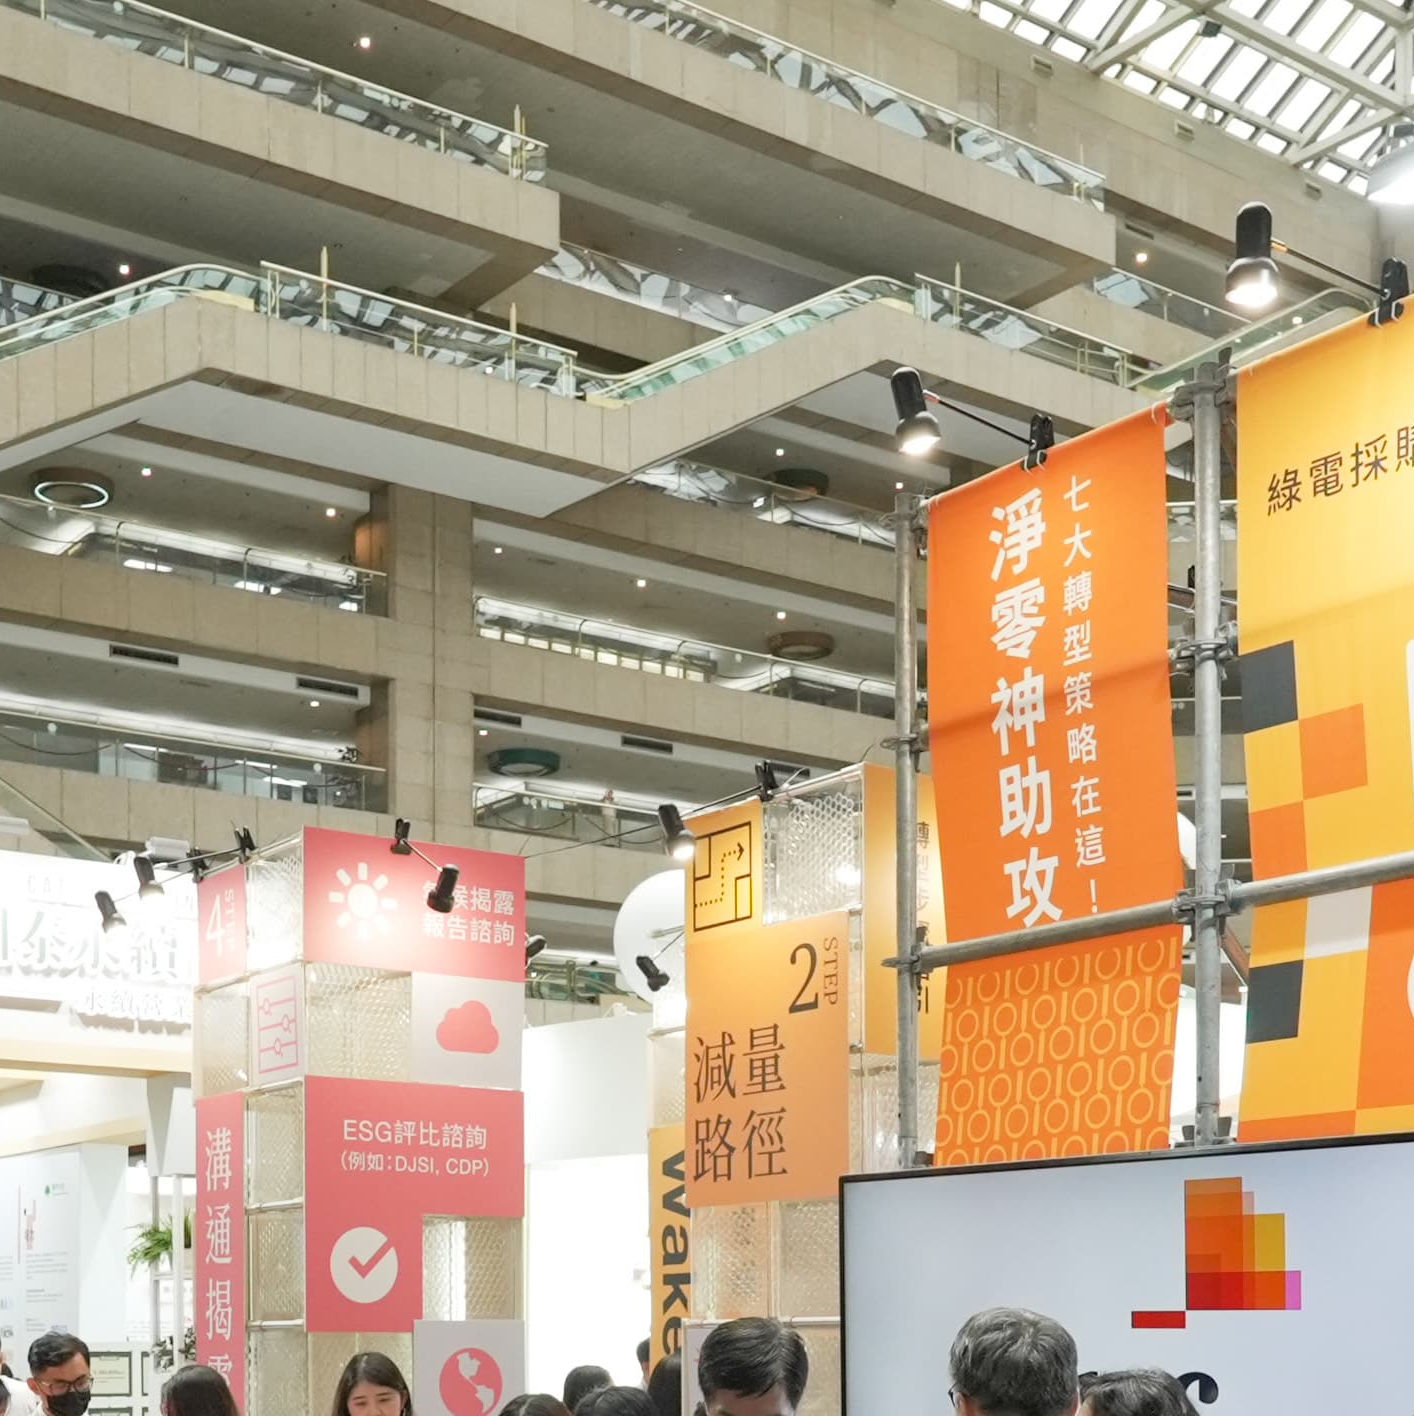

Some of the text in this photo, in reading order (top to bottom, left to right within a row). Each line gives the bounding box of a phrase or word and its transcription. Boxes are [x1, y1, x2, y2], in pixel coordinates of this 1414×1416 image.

[989, 486, 1063, 928] 淨零神助攻
[205, 893, 226, 957] 4
[421, 912, 515, 947] 報告諮詢
[788, 935, 838, 1015] 2 STEP
[692, 1022, 787, 1104] 減量
[343, 1119, 487, 1150] ESG評比諮詢
[692, 1106, 788, 1184] 路徑
